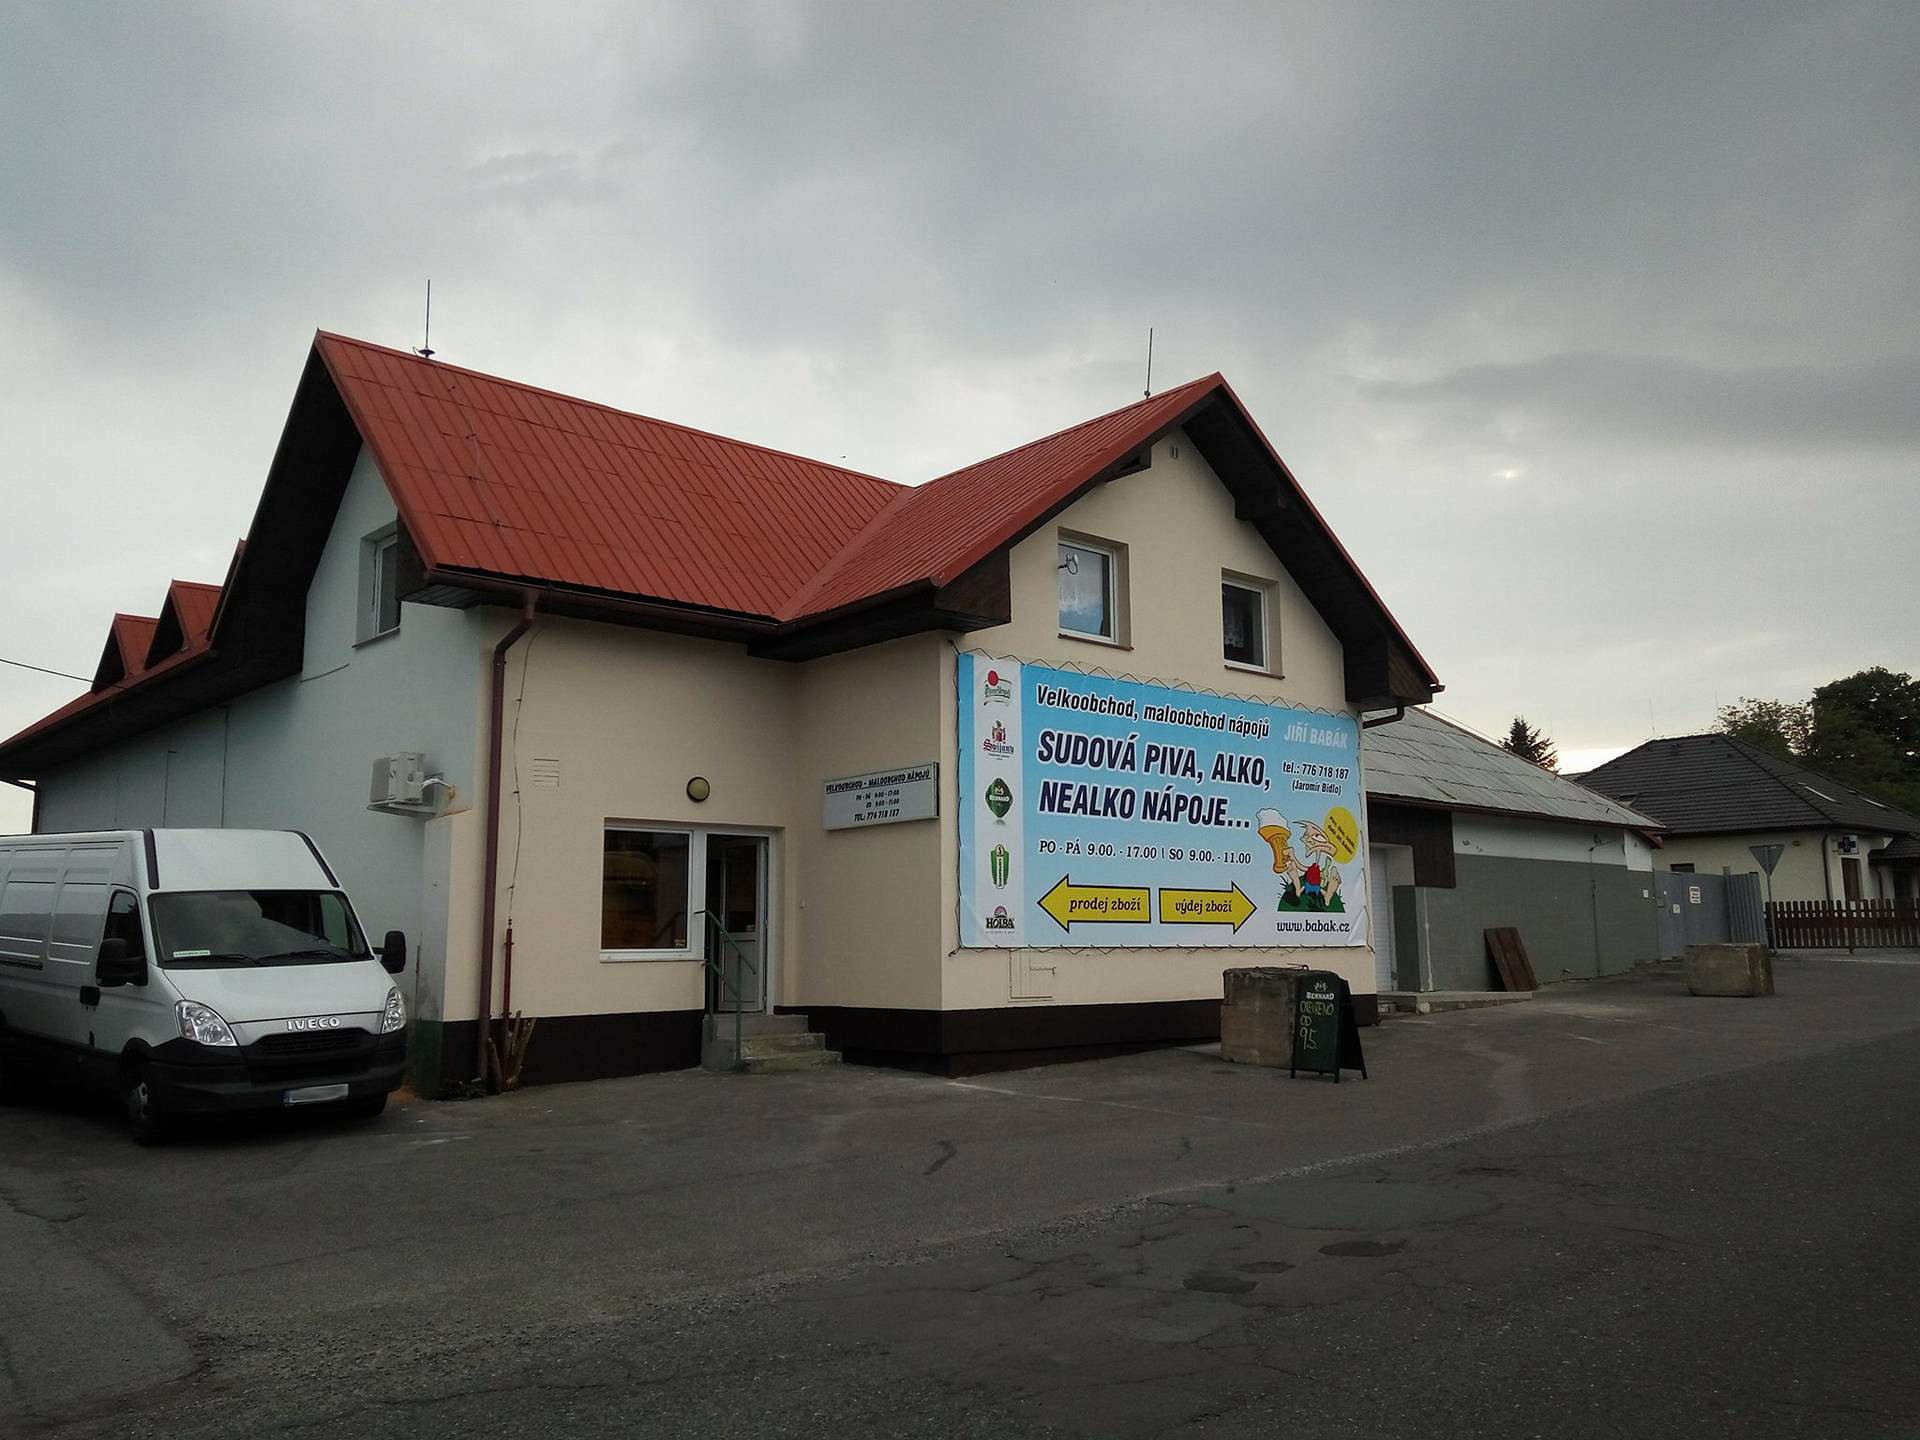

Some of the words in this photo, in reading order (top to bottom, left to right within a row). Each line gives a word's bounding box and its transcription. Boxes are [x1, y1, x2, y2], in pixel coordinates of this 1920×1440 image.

[1037, 684, 1138, 722] Velkoobchod,
[1144, 705, 1226, 730] maloobchod
[1229, 716, 1269, 739] nápojů
[1284, 721, 1308, 743] JIŘÍ
[1311, 728, 1349, 749] BABÁK
[1038, 730, 1138, 771] SUDOVÁ
[1144, 744, 1203, 784] PIVA,
[1211, 753, 1271, 790] ALKO,
[1283, 761, 1300, 774] tel.:
[1302, 764, 1317, 776] 776
[1319, 766, 1333, 778] 718
[1336, 768, 1349, 780] 187
[1292, 780, 1320, 792] (Jaromír
[1322, 783, 1342, 796] Bidlo)
[1039, 781, 1136, 818] NEALKO
[1142, 785, 1250, 828] NÁPOJE...
[1039, 840, 1056, 853] PO
[1066, 838, 1081, 854] PÁ
[1126, 846, 1157, 859] 17.00
[1169, 849, 1184, 860] SO
[1223, 852, 1251, 864] 11.00
[1069, 896, 1109, 914] prodej
[1111, 896, 1141, 911] zboží
[1175, 901, 1203, 915] výdej
[1205, 900, 1232, 912] zboží
[1276, 919, 1350, 932] www.babak.cz
[1306, 991, 1335, 1000] BERNARD
[287, 1016, 341, 1031] IVECO
